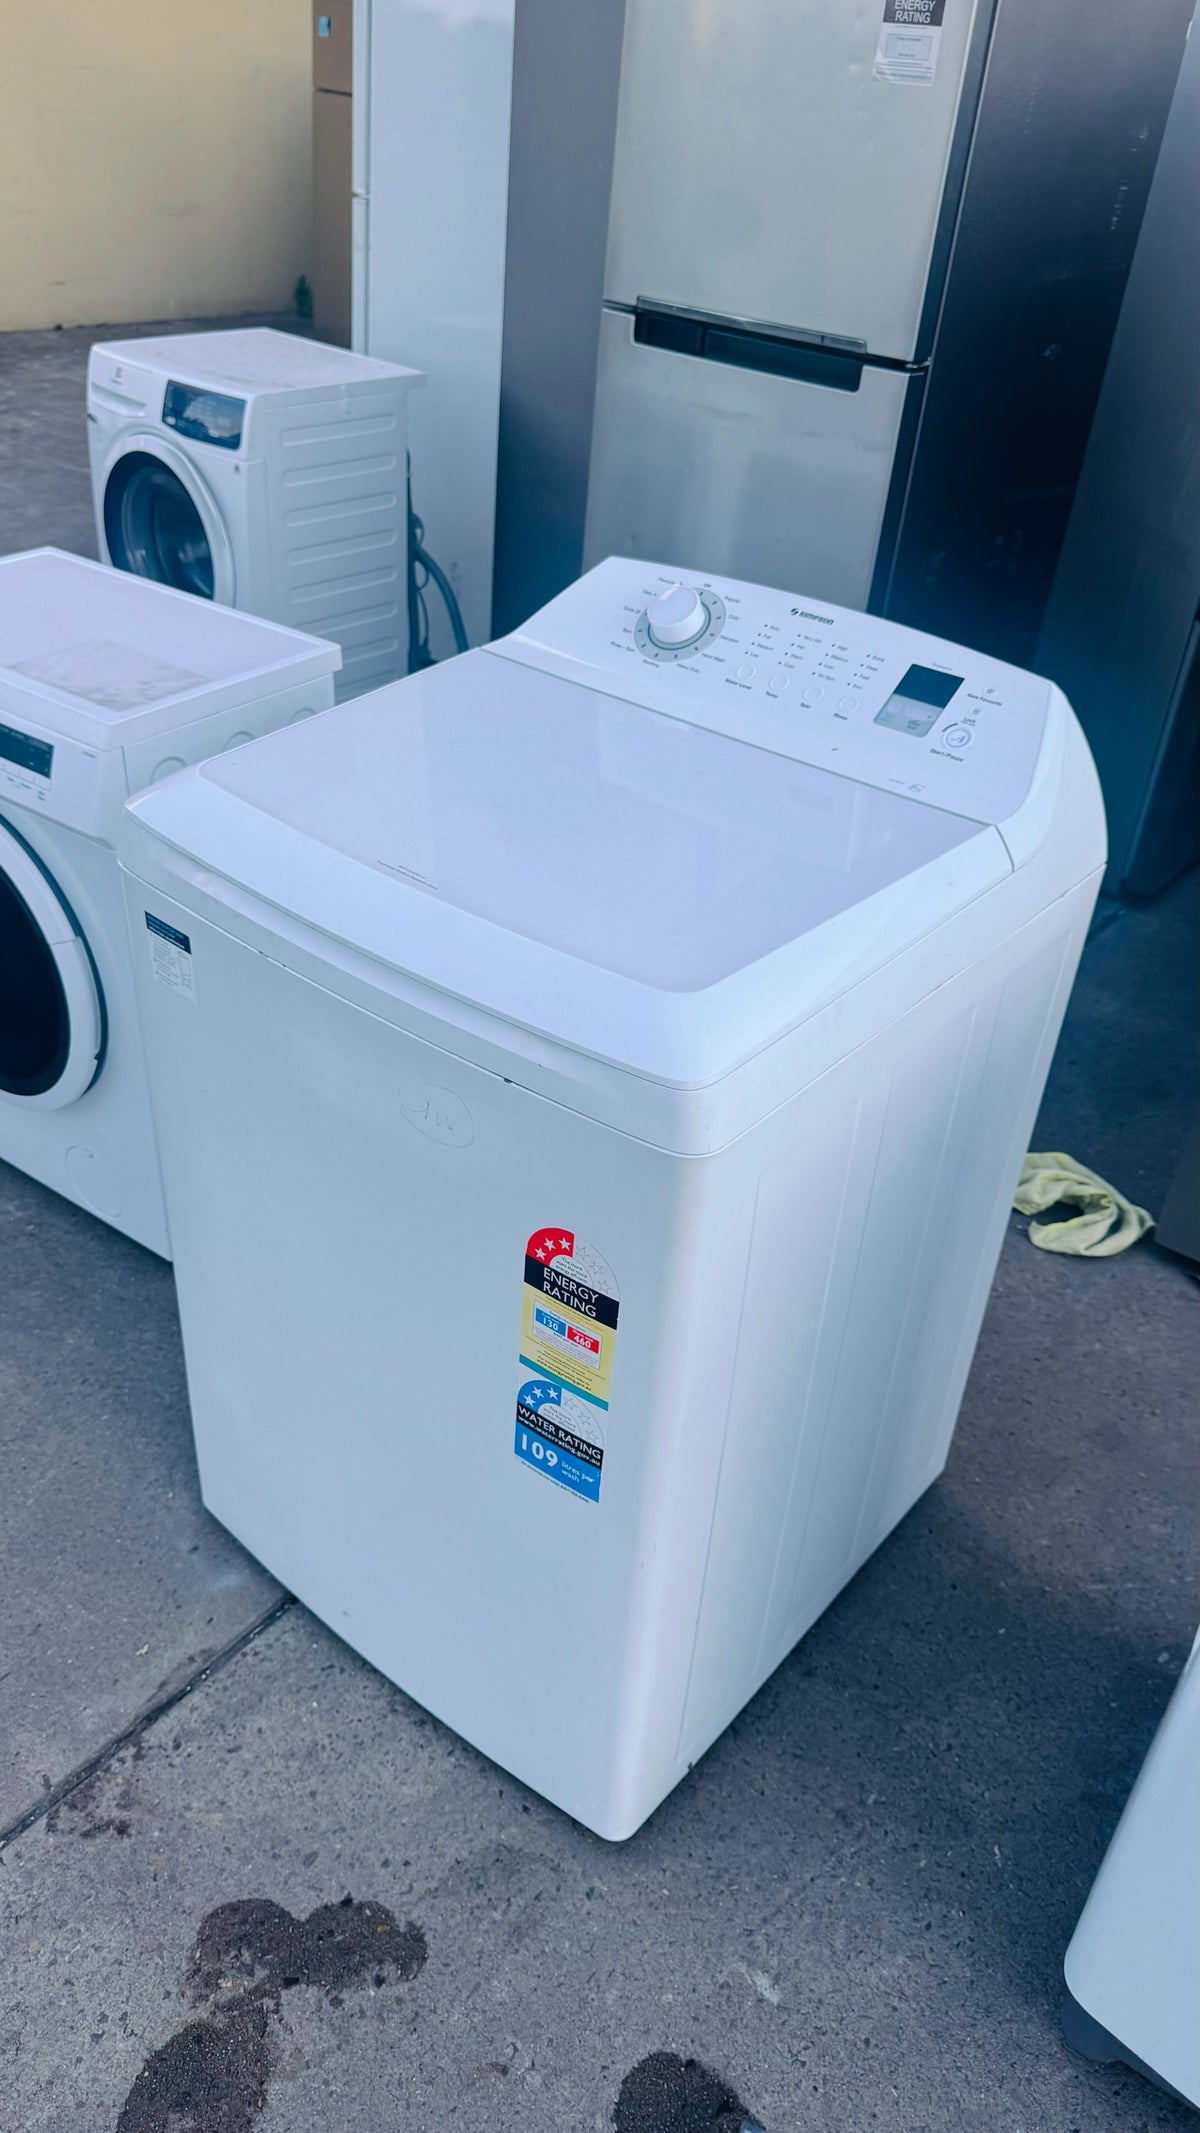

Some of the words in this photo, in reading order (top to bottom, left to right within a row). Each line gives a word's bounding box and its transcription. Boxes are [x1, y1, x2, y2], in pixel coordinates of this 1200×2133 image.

[894, 0, 936, 12] ENERGY
[895, 11, 931, 23] RATING
[543, 1267, 599, 1303] ENERGY
[543, 1281, 596, 1317] RATING
[542, 1317, 559, 1331] 130
[573, 1335, 592, 1349] 460
[518, 1405, 556, 1435] WATER
[558, 1430, 601, 1459] RATING
[518, 1415, 601, 1466] www.waterrating.gov.au
[521, 1433, 558, 1467] 109
[561, 1460, 580, 1476] litres
[581, 1473, 595, 1483] per
[561, 1469, 580, 1483] wash
